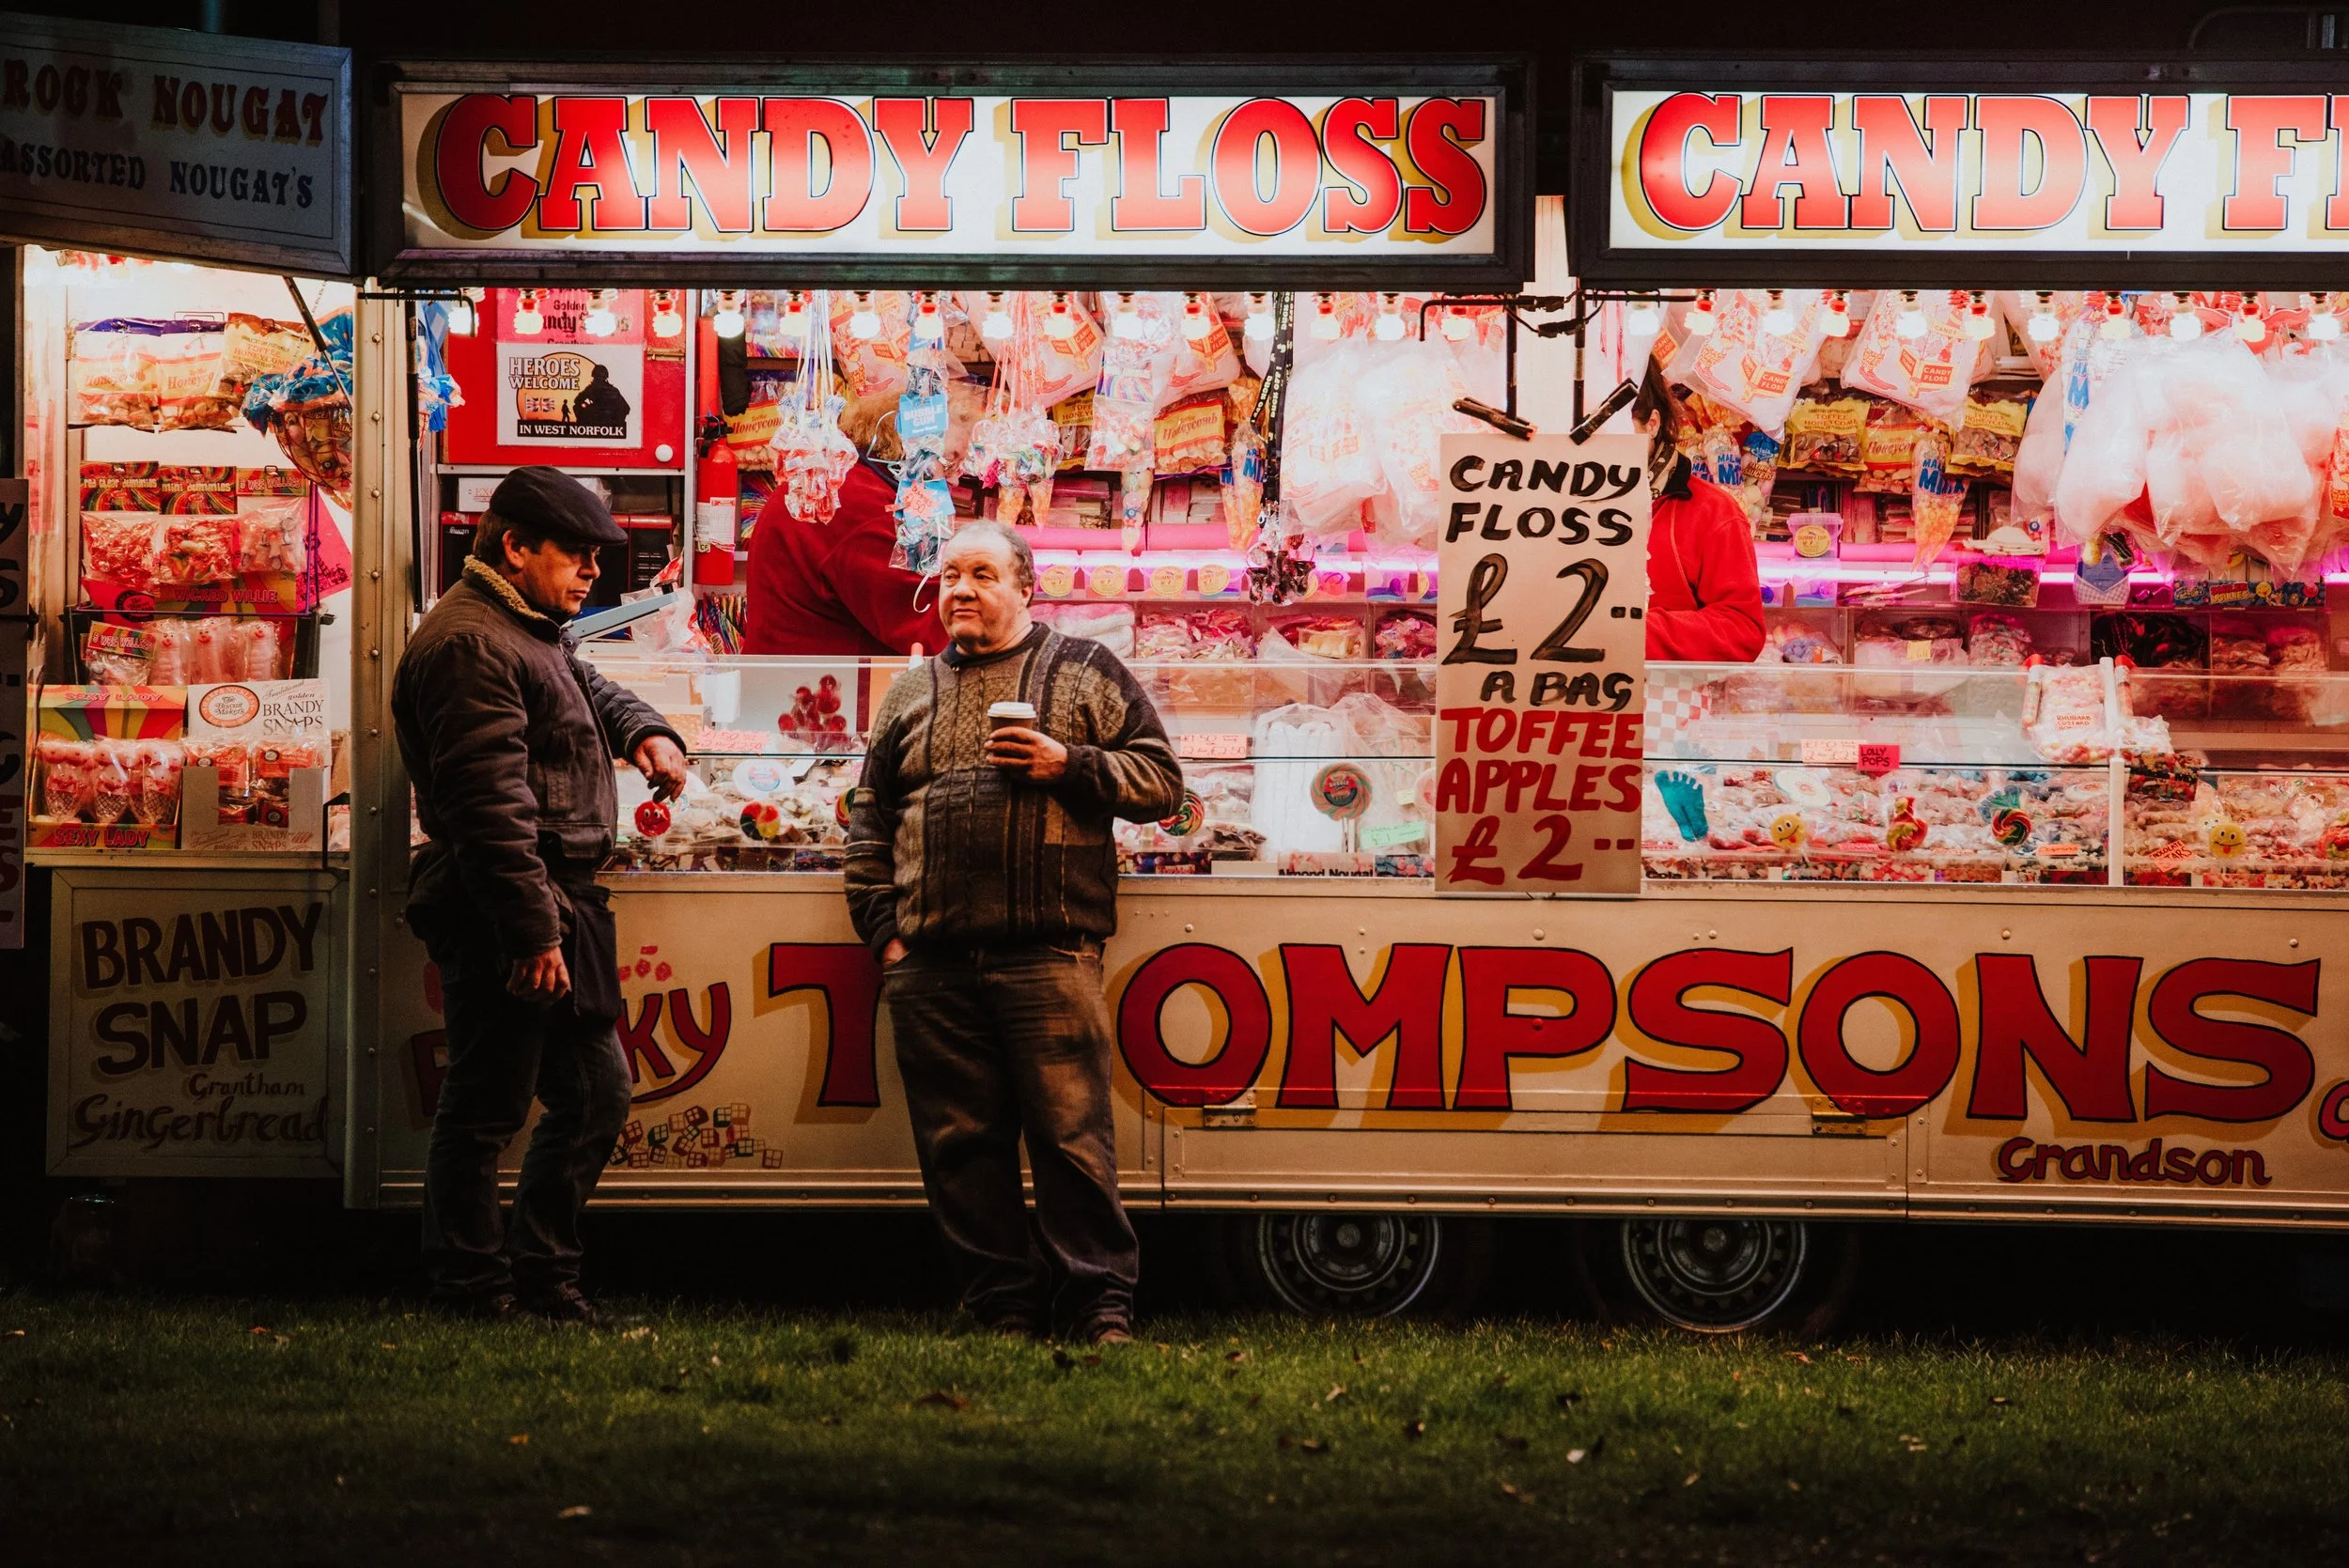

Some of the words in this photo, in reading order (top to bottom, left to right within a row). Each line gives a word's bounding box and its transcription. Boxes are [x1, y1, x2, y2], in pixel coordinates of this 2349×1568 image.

[3, 58, 124, 119] ROCK
[152, 74, 328, 142] NOUGAT
[0, 140, 147, 190] ASSORTED
[169, 161, 314, 210] NOUGAT'S
[436, 94, 974, 233] CANDY
[1011, 97, 1487, 236] FLOSS
[1639, 91, 2190, 232] CANDY
[2223, 94, 2349, 232] F
[508, 356, 580, 377] HEROES
[508, 377, 581, 390] WELCOME
[1923, 367, 1952, 376] CANDY
[520, 424, 532, 434] IN
[535, 425, 567, 435] WEST
[568, 426, 624, 436] NORFOLK
[1162, 413, 1219, 441] Honeycomb
[1450, 455, 1642, 503] CANDY
[1445, 501, 1634, 547] FLOSS
[173, 586, 229, 602] WICKED
[232, 589, 279, 604] WILLIE
[64, 692, 111, 701] SEXY
[115, 693, 163, 702] LADY
[263, 699, 324, 718] BRANDY
[1480, 670, 1517, 705] A
[1530, 670, 1635, 712] BAG
[263, 715, 323, 736] SNAPS
[1439, 706, 1644, 760] TOFFEE
[1861, 756, 1890, 768] POPS
[1436, 757, 1641, 814] APPLES
[53, 828, 100, 846] SEXY
[103, 828, 150, 846] LADY
[252, 830, 289, 840] BRANDY
[82, 901, 324, 990] BRANDY
[96, 989, 307, 1076] SNAP
[768, 942, 2321, 1123] TOMPSONS
[188, 1072, 305, 1099] Grantham
[67, 1093, 329, 1152] Gingerbread
[1998, 1137, 2273, 1187] Grandson
